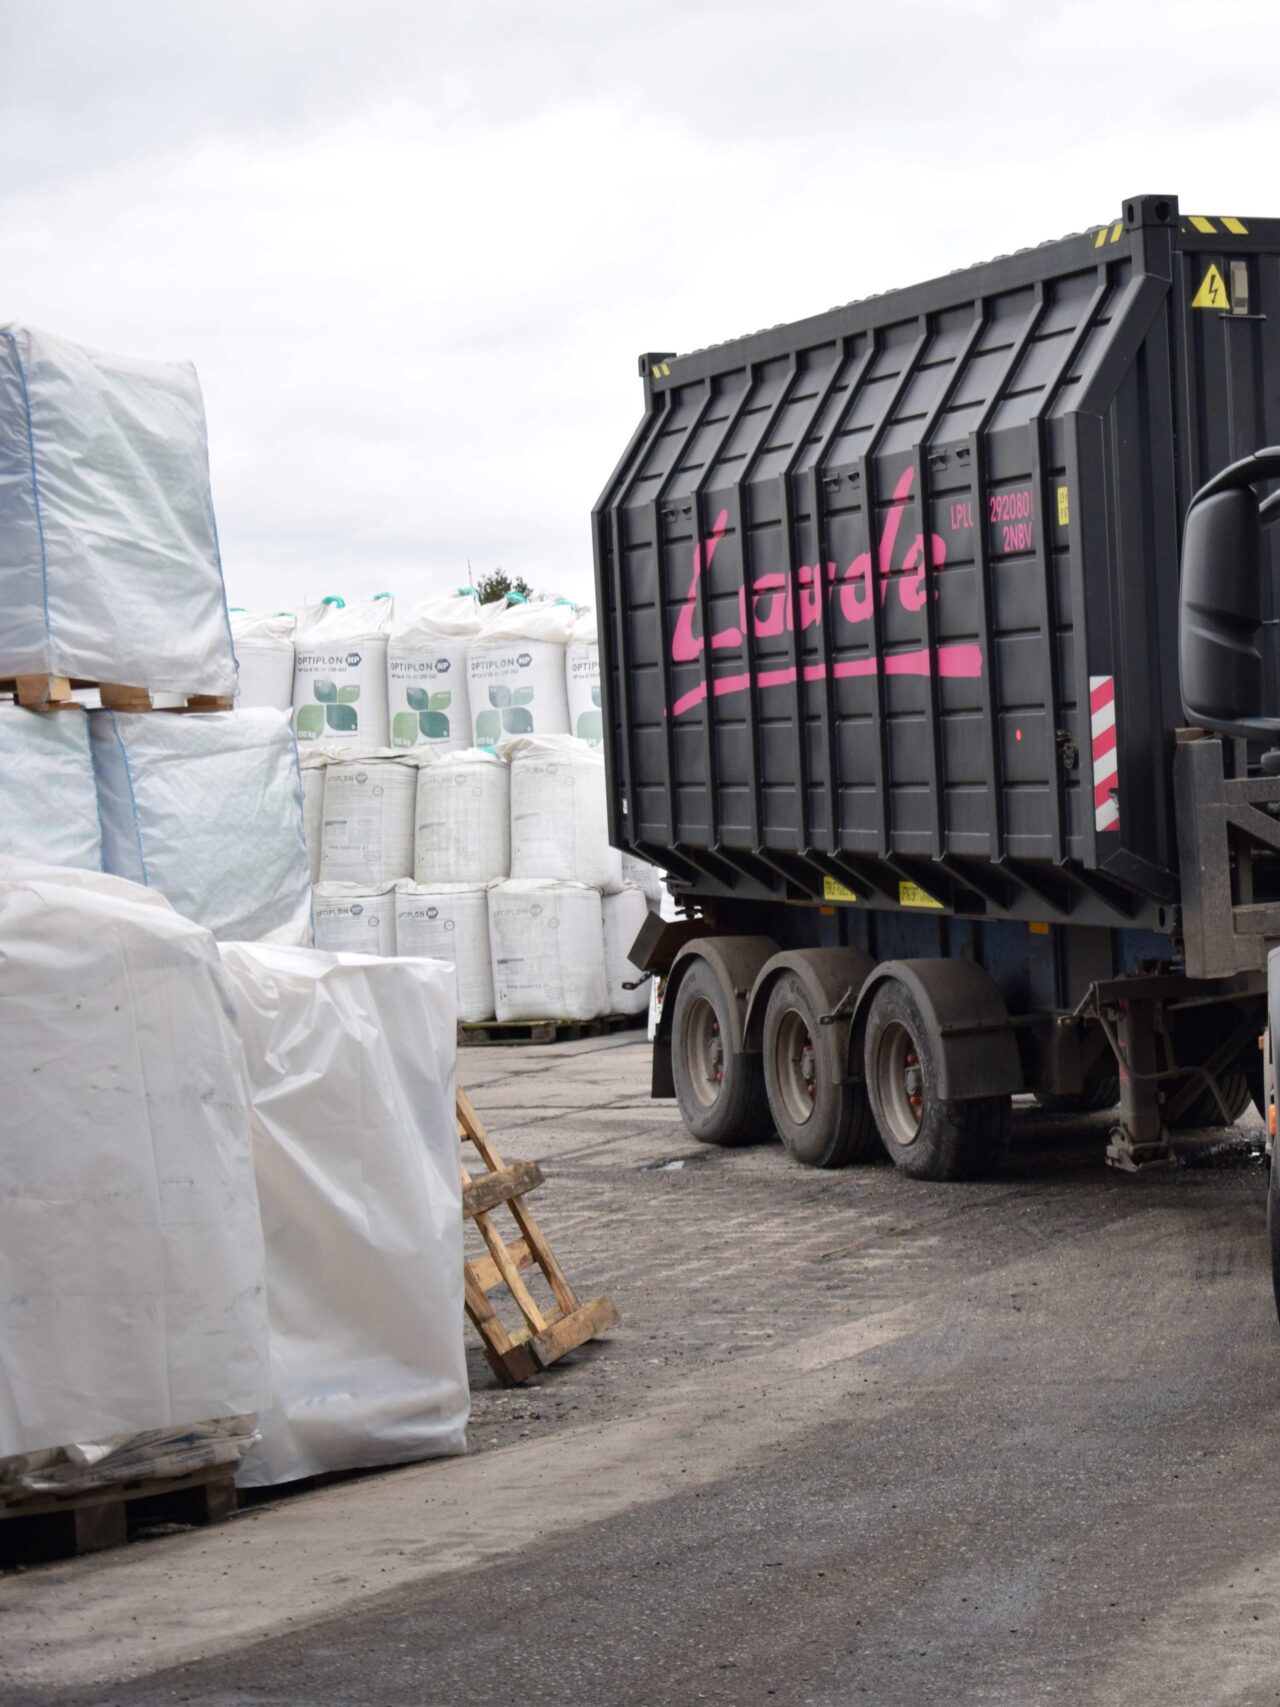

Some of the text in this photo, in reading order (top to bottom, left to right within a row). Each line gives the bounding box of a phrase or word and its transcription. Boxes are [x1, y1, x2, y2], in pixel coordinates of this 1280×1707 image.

[297, 654, 343, 665] OPTIPLON
[471, 658, 515, 671] OPTIPLON
[391, 661, 433, 672] OPTIPLON
[572, 661, 600, 672] OPTIP
[316, 907, 349, 917] OPTIPLON
